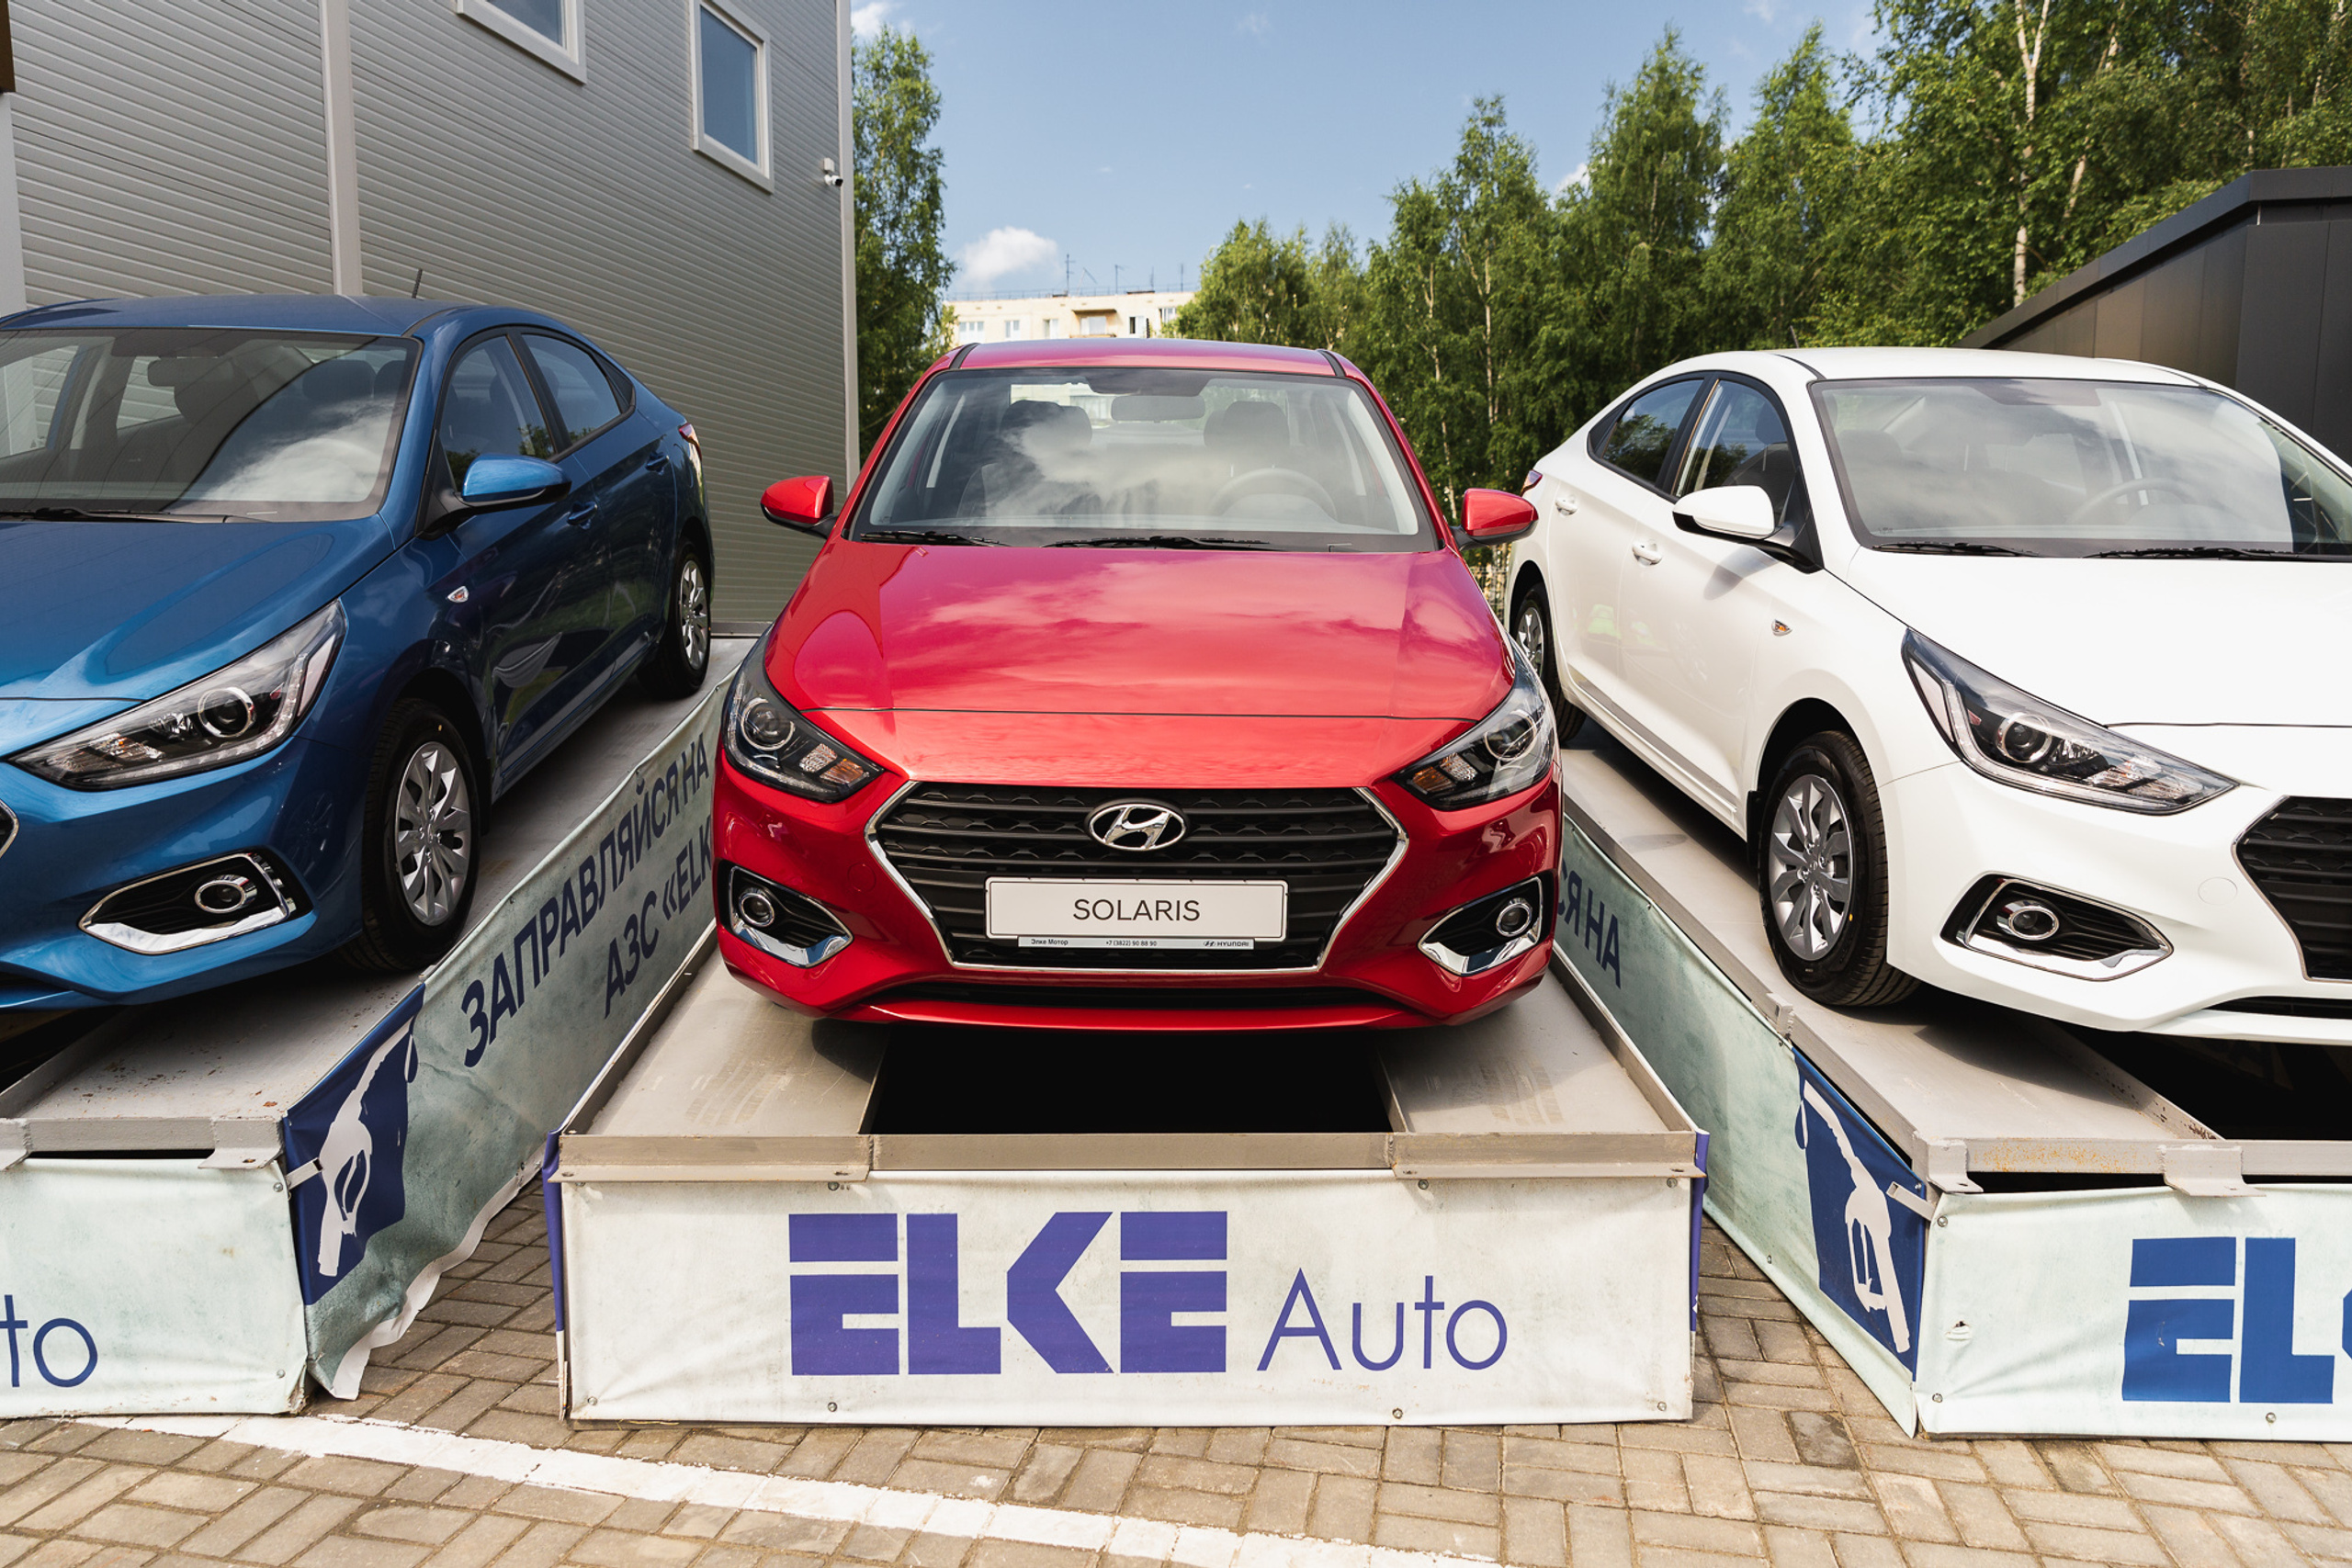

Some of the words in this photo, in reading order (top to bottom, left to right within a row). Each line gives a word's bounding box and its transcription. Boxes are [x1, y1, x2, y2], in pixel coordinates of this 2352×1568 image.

[461, 760, 680, 1067] ЗАПРАВЛЯЙСЯ
[681, 732, 709, 806] НА
[604, 890, 660, 1019] АЗС
[1073, 898, 1201, 921] SOLARIS
[788, 1211, 1227, 1375] ELKE
[1256, 1268, 1508, 1371] Auto
[2121, 1236, 2352, 1404] EL
